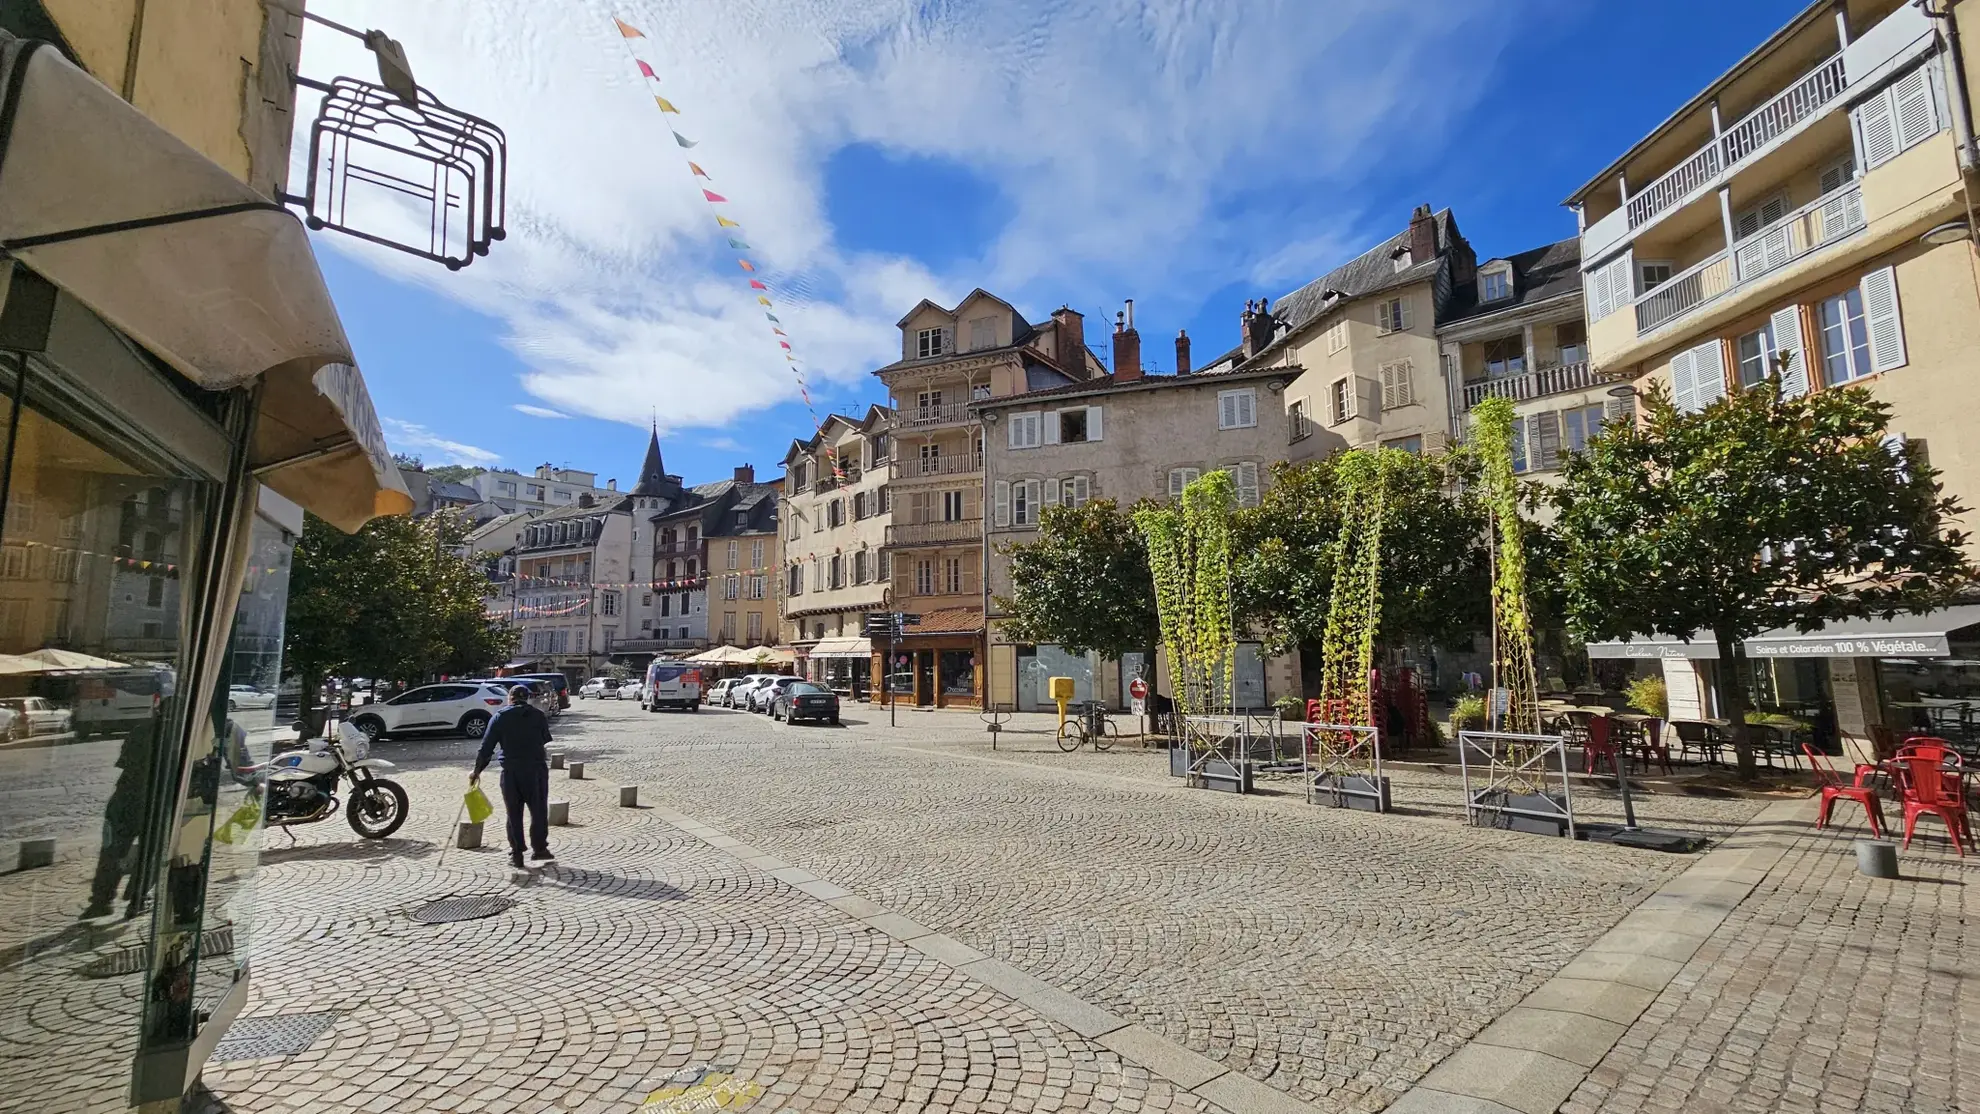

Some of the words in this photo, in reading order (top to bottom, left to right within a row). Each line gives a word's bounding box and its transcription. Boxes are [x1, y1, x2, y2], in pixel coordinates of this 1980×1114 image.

[1656, 646, 1686, 657] Nature
[1755, 645, 1777, 654] Soins
[1779, 645, 1788, 654] et
[1789, 644, 1834, 654] Coloration
[1835, 642, 1854, 653] 100
[1856, 642, 1869, 653] %
[1871, 640, 1937, 655] Végétale...
